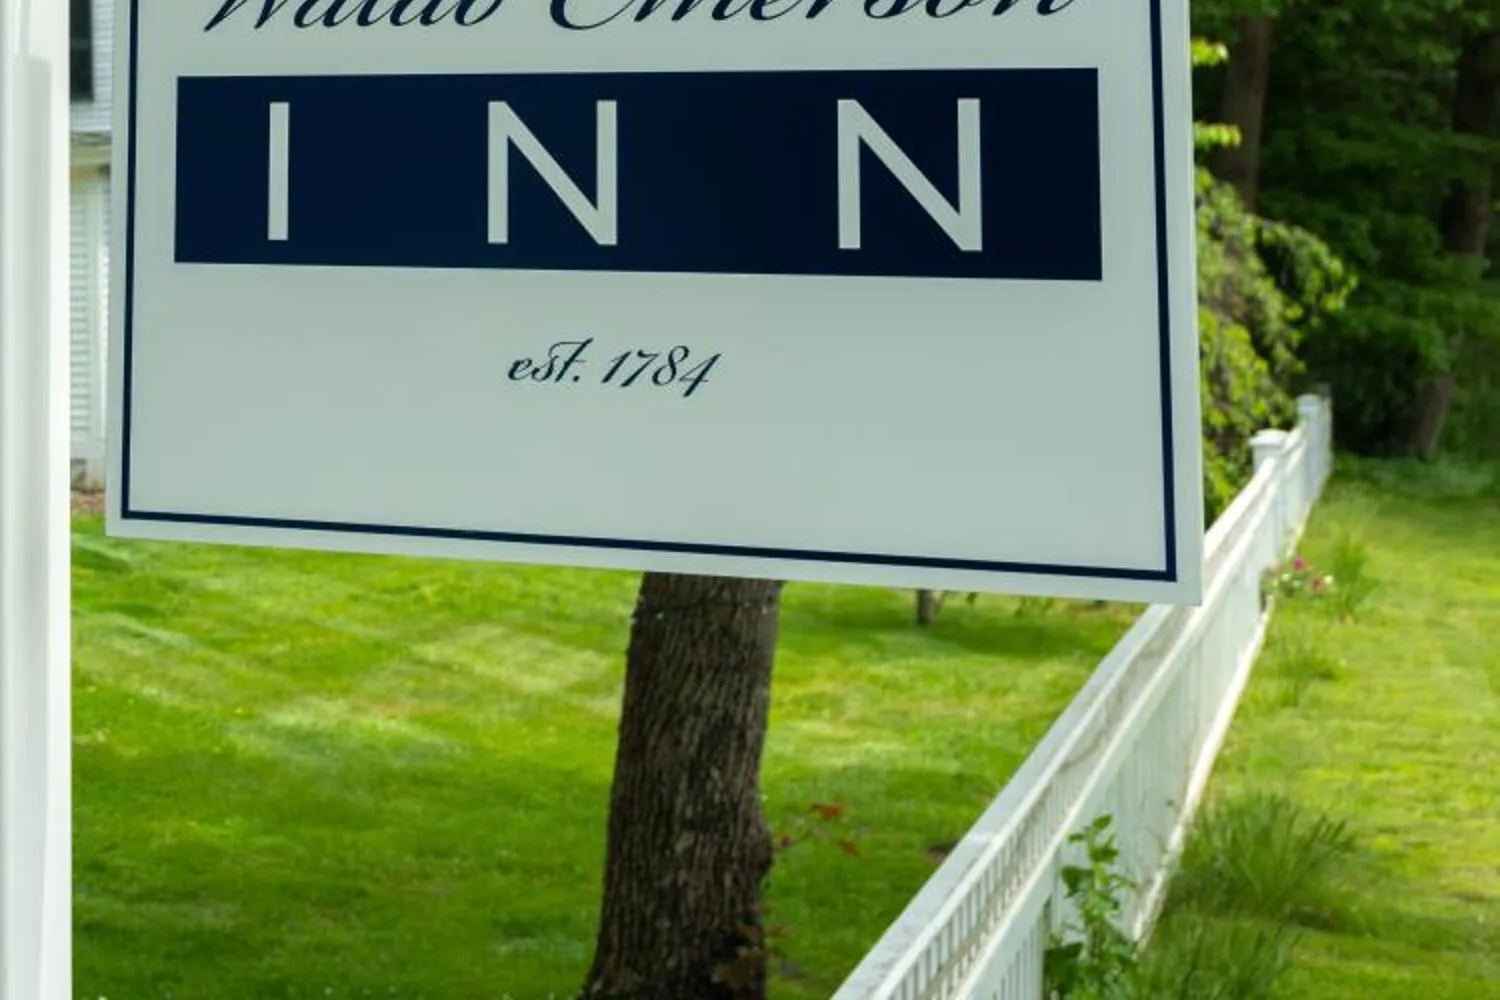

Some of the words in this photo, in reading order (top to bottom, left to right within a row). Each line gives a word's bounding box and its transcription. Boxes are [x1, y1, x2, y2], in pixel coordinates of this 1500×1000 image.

[267, 98, 983, 251] INN
[506, 337, 594, 384] est.
[601, 345, 722, 398] 1784
